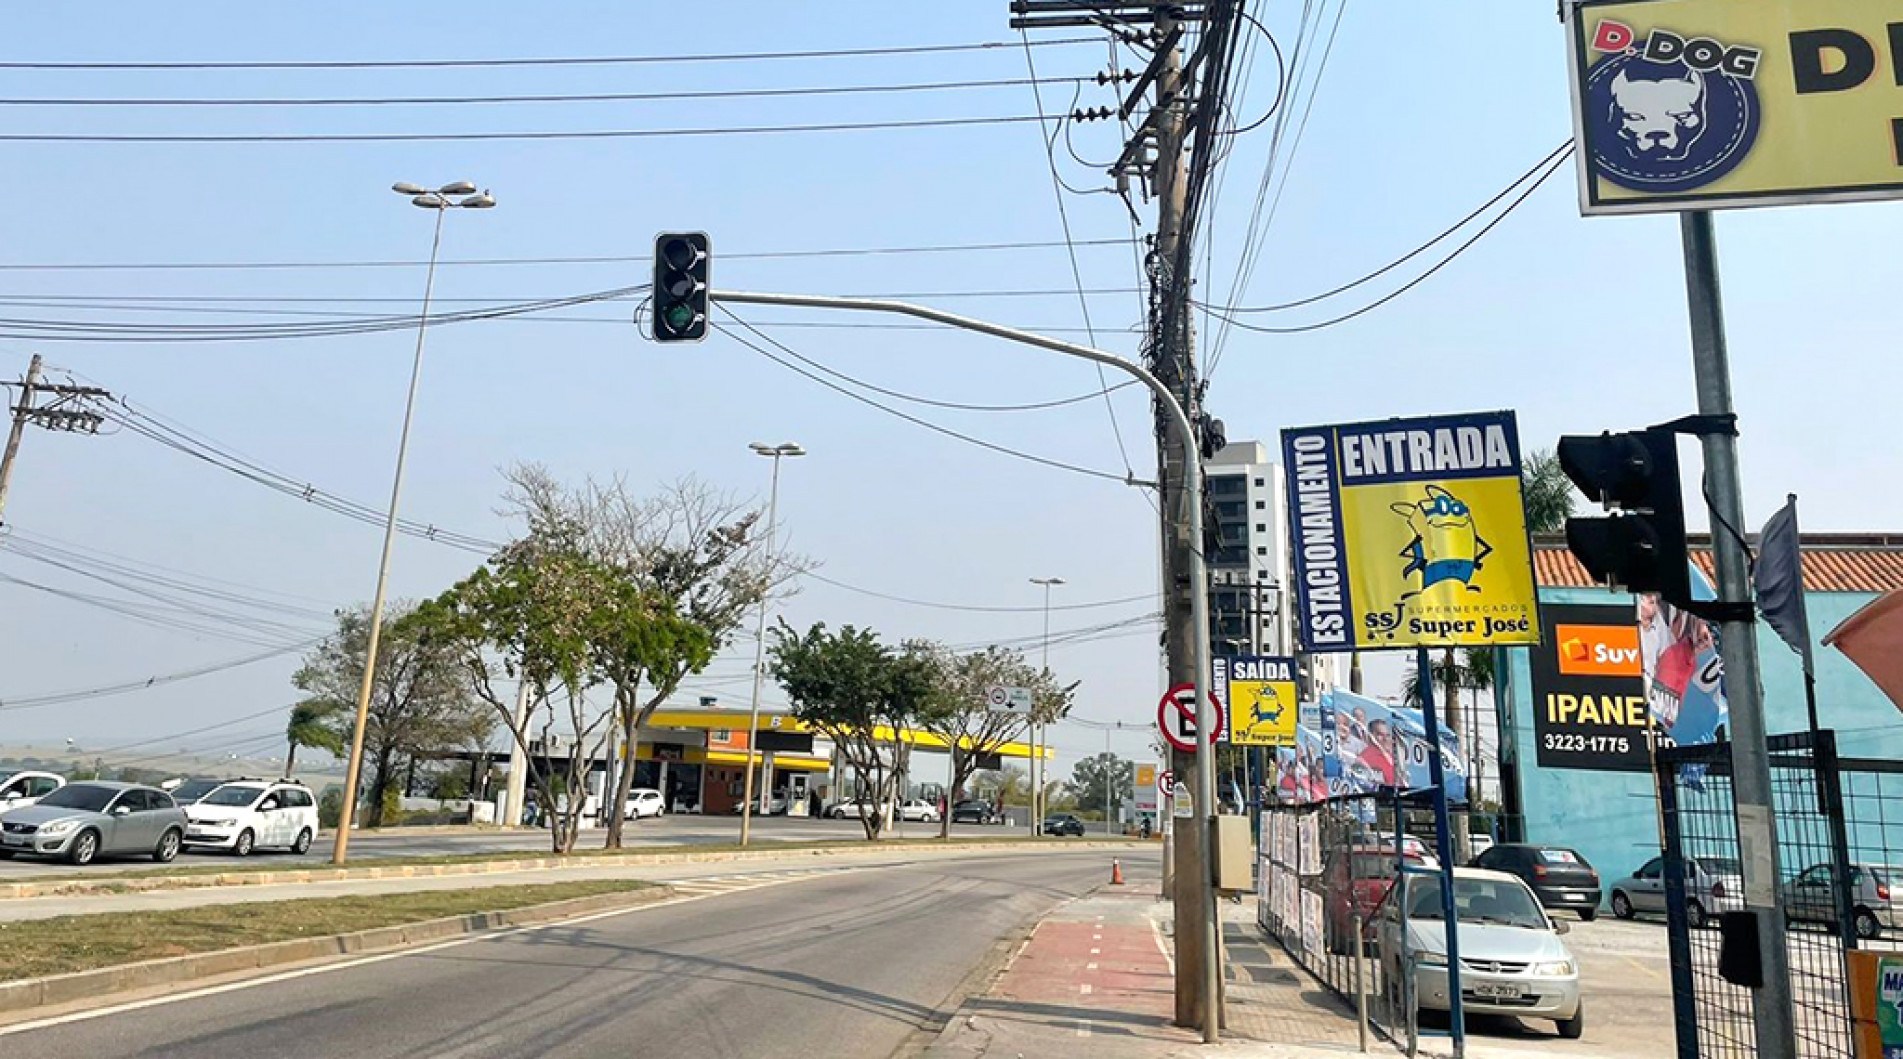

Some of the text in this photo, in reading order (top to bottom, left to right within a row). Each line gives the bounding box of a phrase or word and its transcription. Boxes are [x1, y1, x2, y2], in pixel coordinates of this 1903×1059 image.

[1788, 21, 1903, 95] D
[1344, 424, 1512, 476] ENTRADA
[1293, 434, 1346, 644] ESTACIONAMENTO
[1409, 614, 1529, 640] Super José
[1233, 659, 1291, 680] SAÍDA
[1544, 733, 1631, 754] 3223-1775
